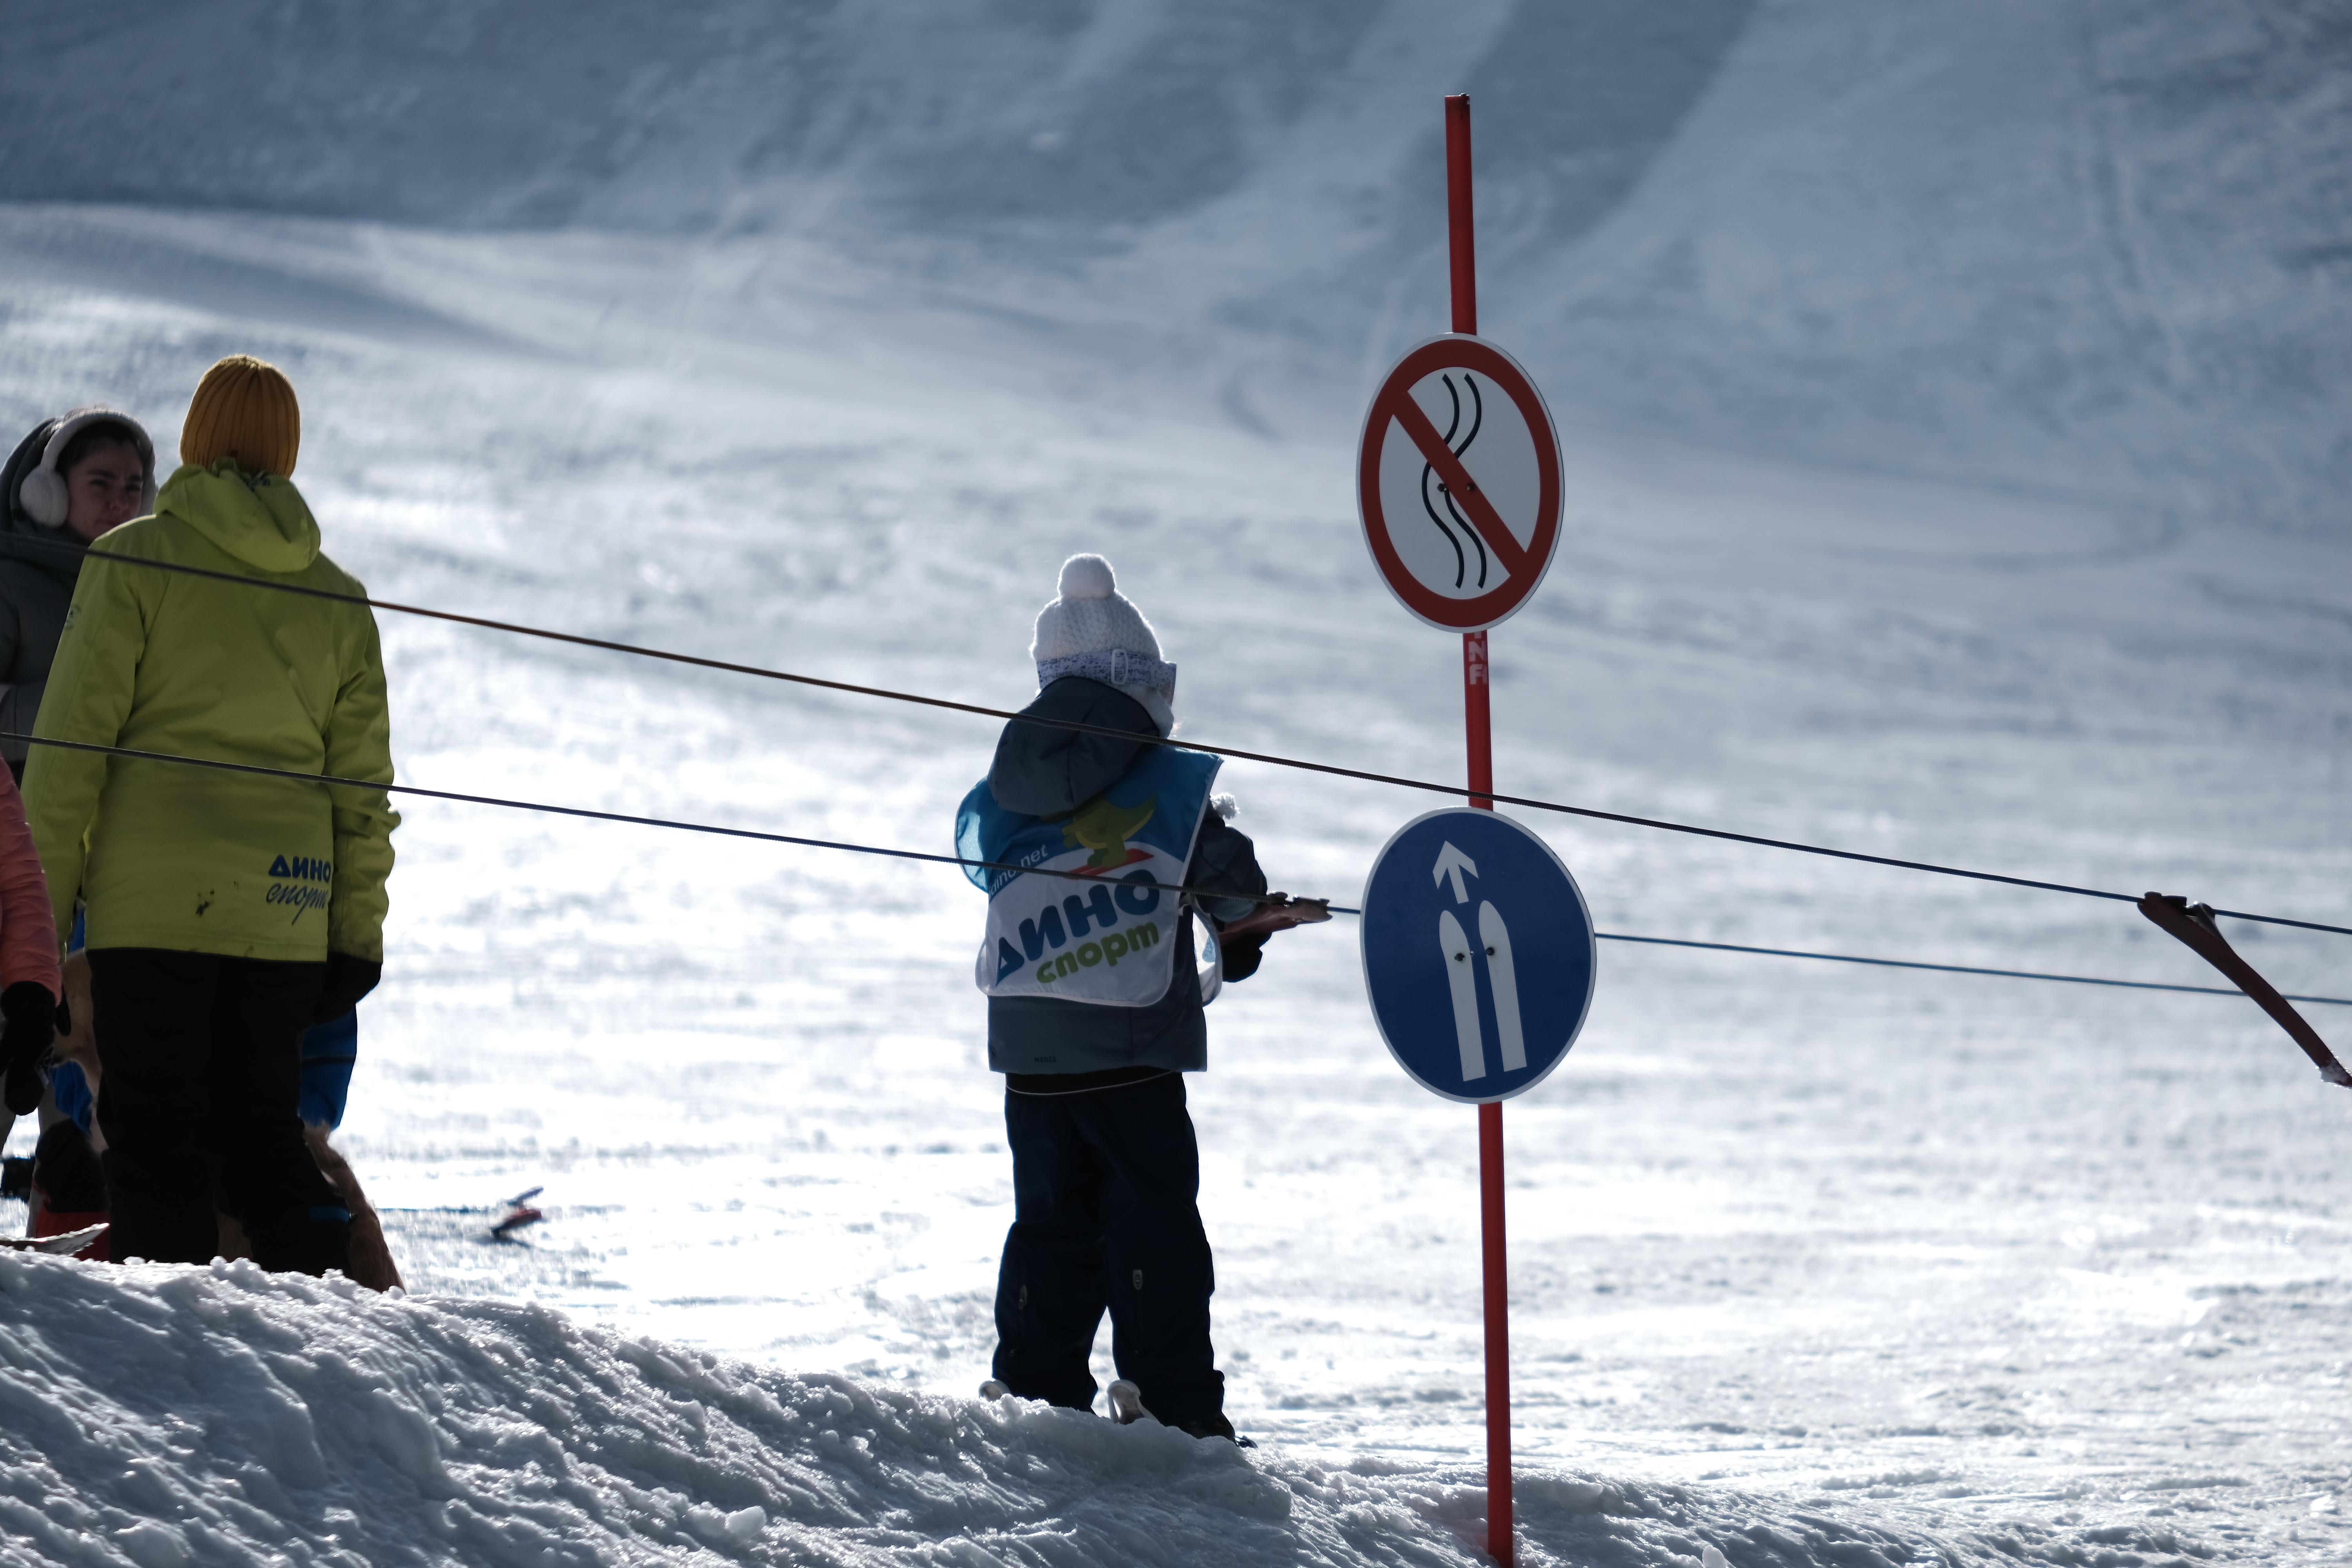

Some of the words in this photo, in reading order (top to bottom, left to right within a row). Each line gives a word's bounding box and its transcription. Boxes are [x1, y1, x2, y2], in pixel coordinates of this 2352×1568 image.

[1468, 631, 1488, 684] NA
[269, 855, 331, 883] ДИНО
[995, 869, 1160, 987] ДИНО
[1036, 922, 1159, 983] спорт
